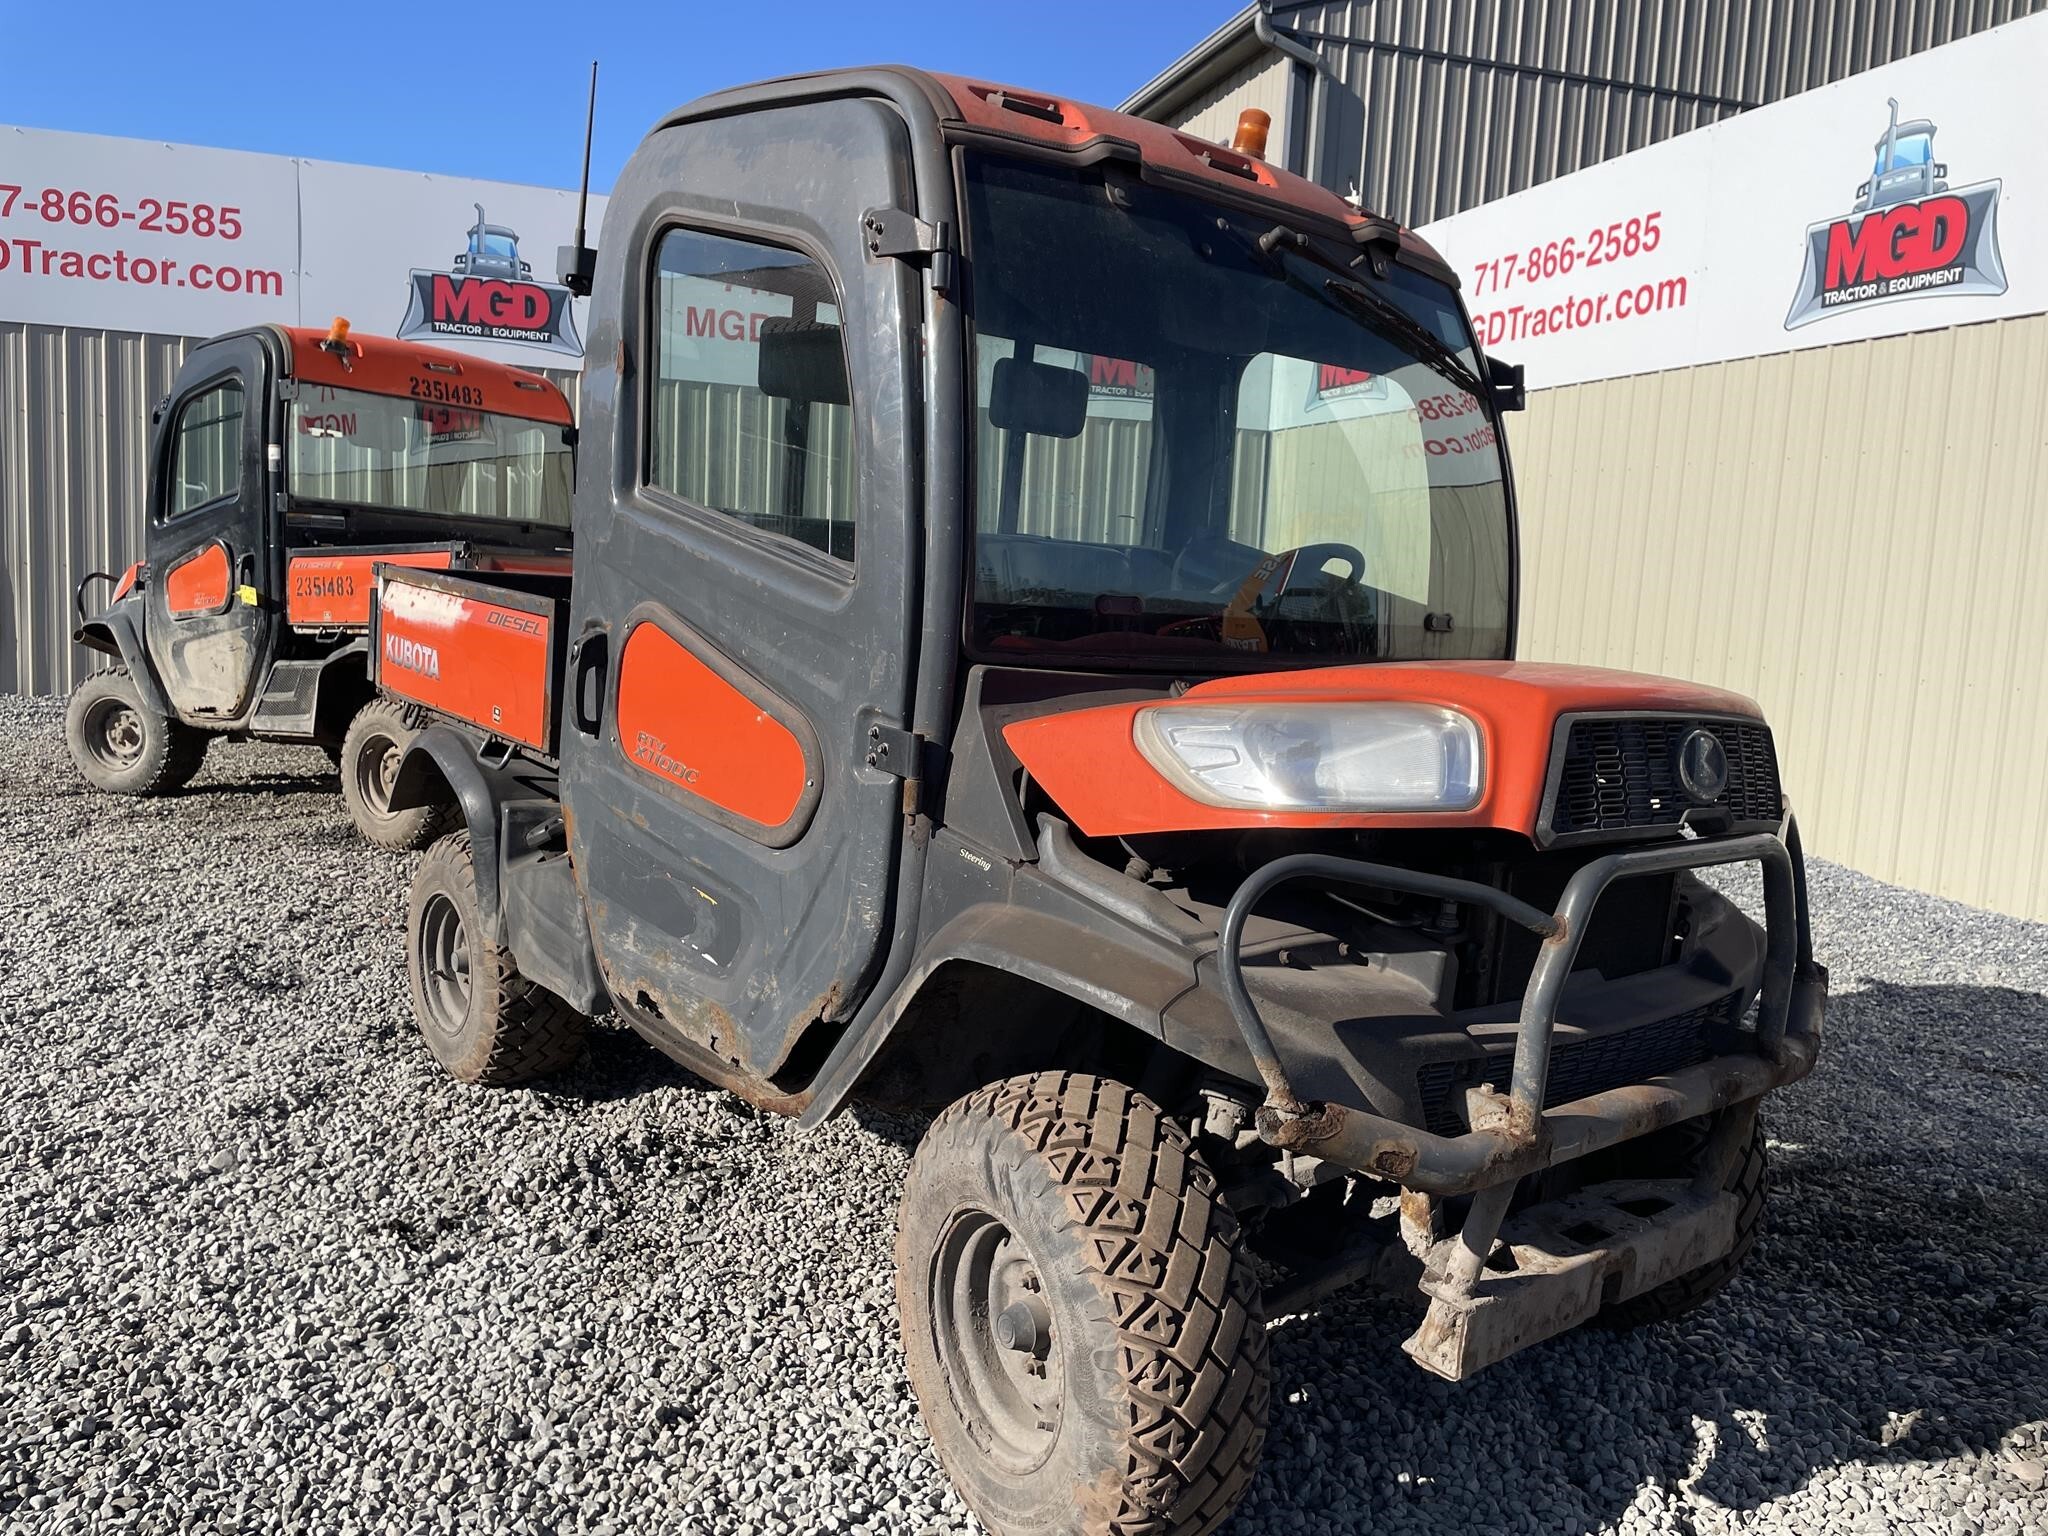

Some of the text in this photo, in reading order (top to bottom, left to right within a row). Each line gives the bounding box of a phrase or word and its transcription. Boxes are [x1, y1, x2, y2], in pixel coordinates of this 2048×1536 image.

[1474, 211, 1662, 297] 717-866-2585
[1825, 197, 1968, 290] MGD
[432, 275, 551, 329] MGD
[1824, 267, 1963, 306] TRACTOR & EQUIPMENT
[434, 321, 482, 335] TRACTOR
[492, 327, 551, 342] EQUIPMENT
[409, 375, 483, 406] 2351483
[296, 575, 354, 597] 2351483
[487, 611, 543, 637] DIESEL
[385, 632, 441, 681] KUBOTA
[638, 731, 666, 752] RTV
[634, 746, 700, 784] X1100C
[959, 847, 992, 872] Steering
